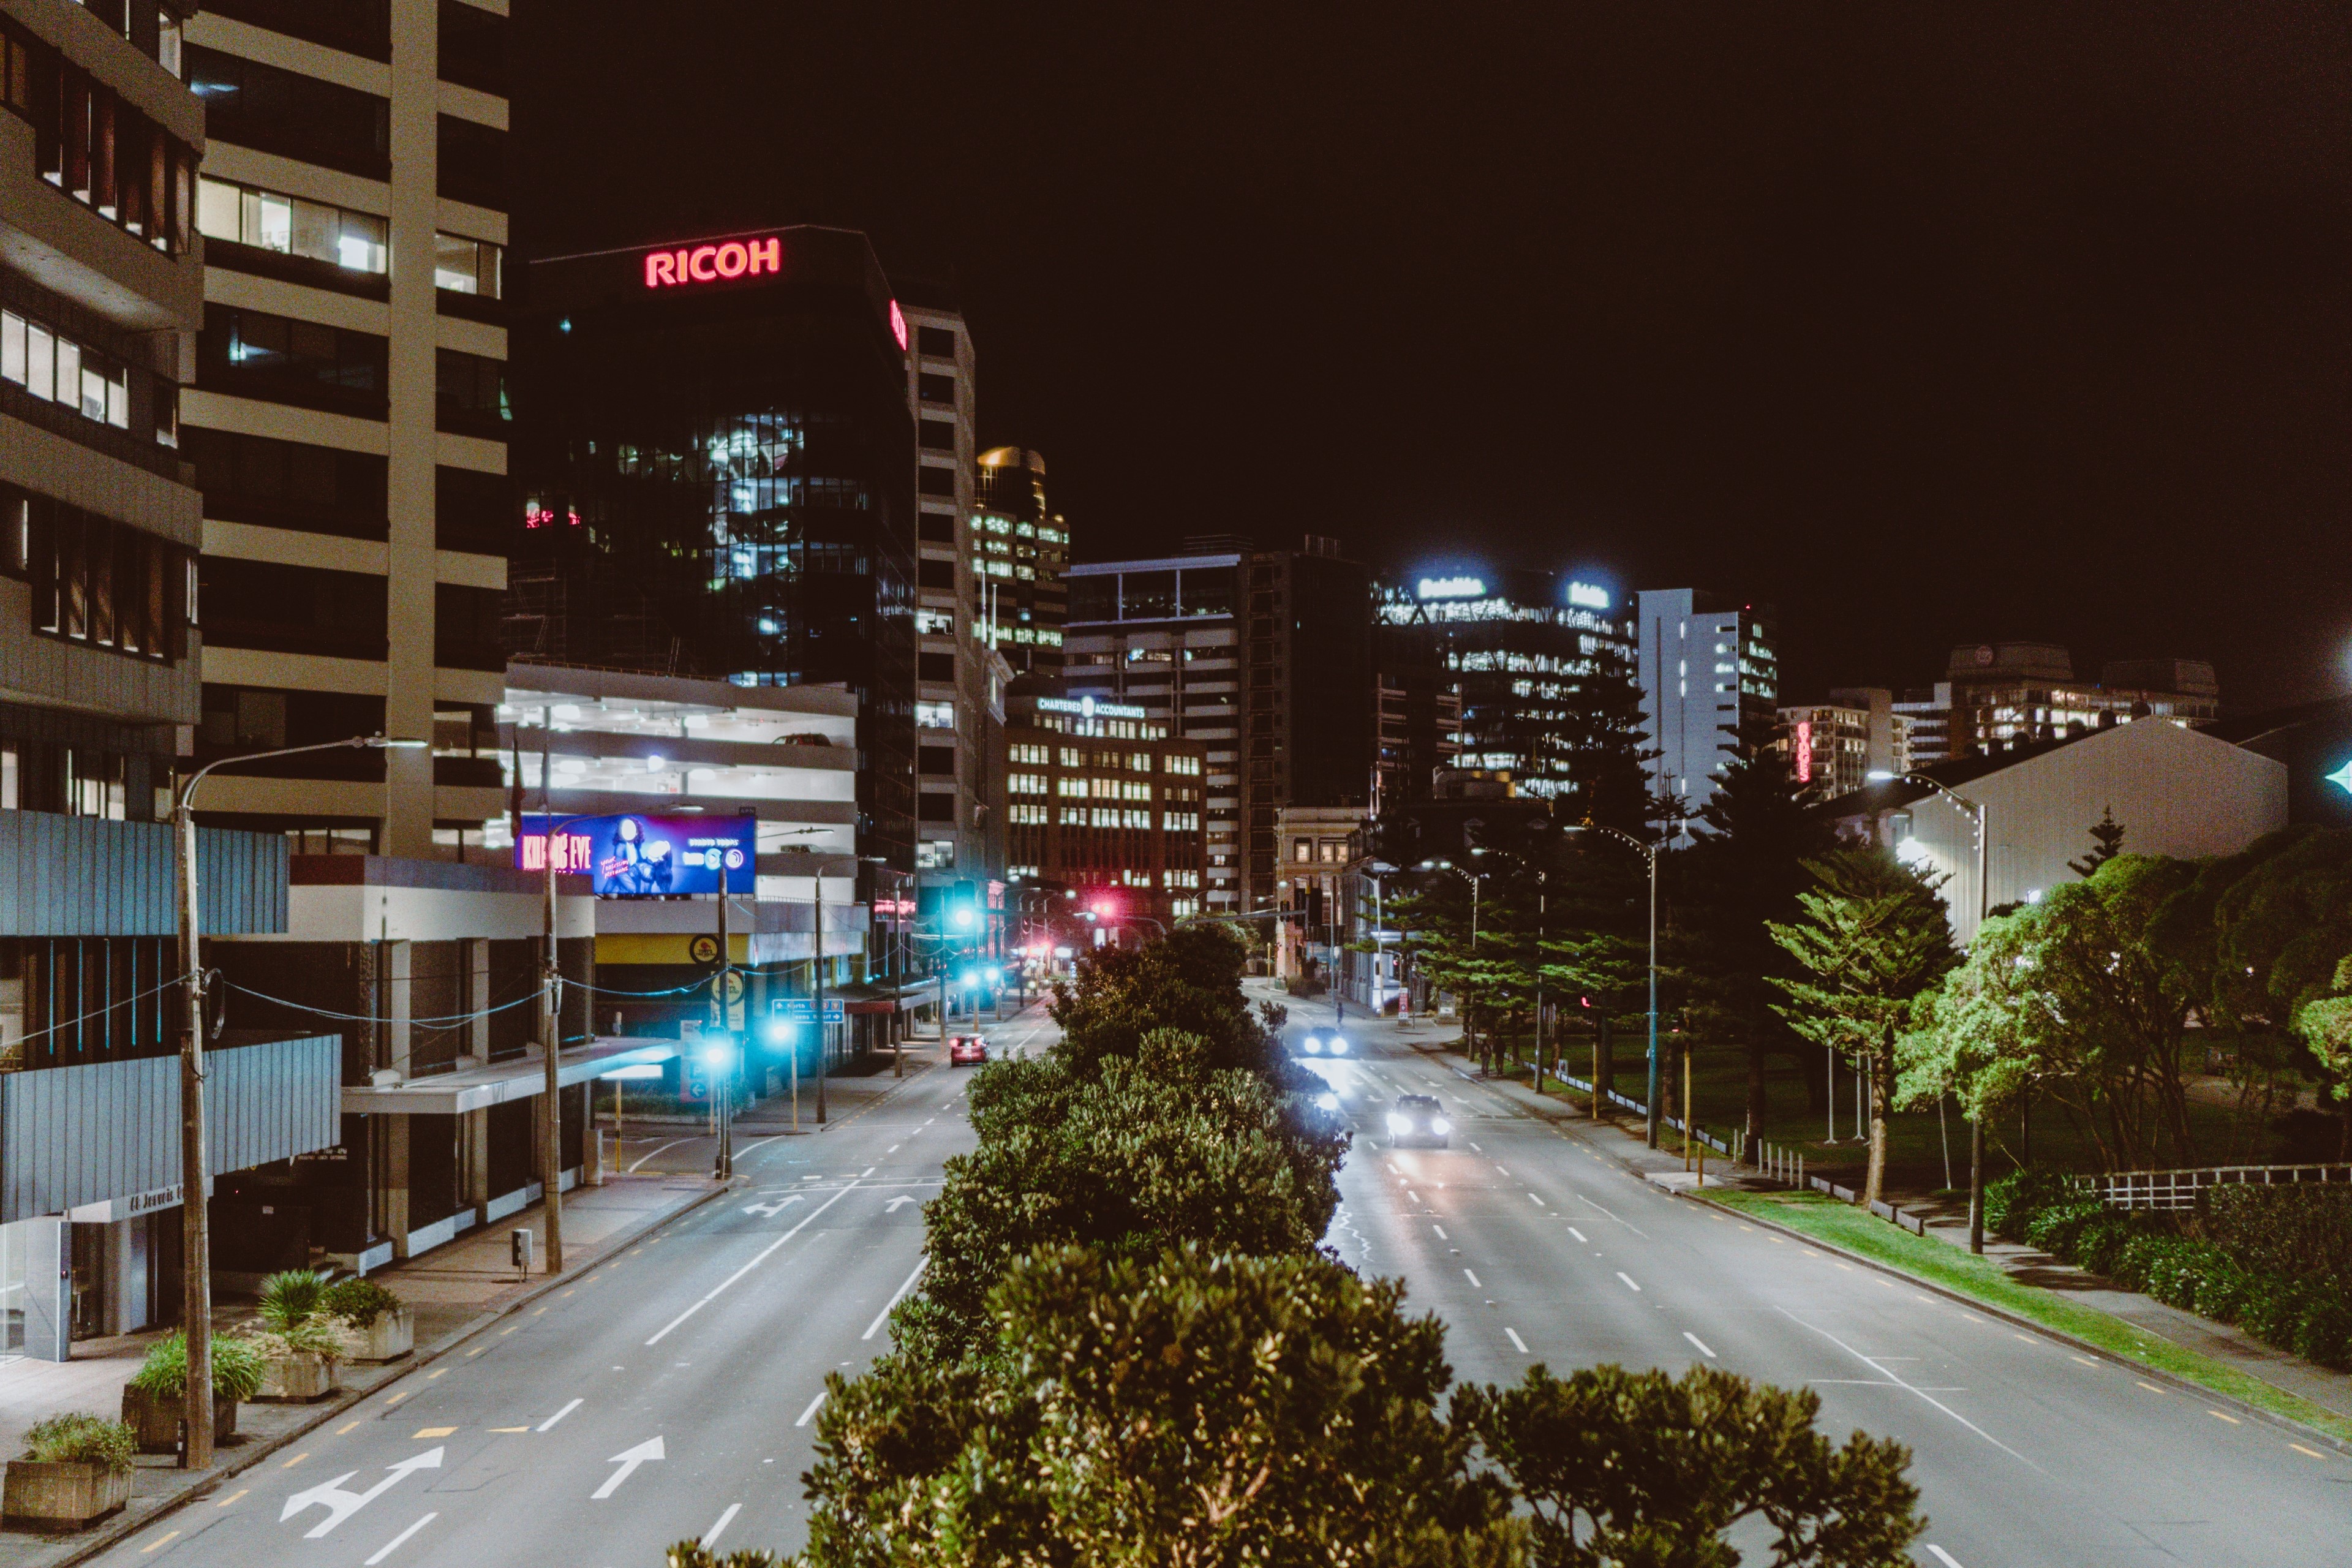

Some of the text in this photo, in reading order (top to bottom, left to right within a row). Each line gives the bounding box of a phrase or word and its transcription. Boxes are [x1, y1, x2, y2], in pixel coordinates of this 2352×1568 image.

[646, 238, 780, 288] RICOH
[1039, 697, 1145, 719] CHARTERED ACCOUNTANTS
[1798, 722, 1810, 782] RYDGES
[570, 836, 591, 870] EVE
